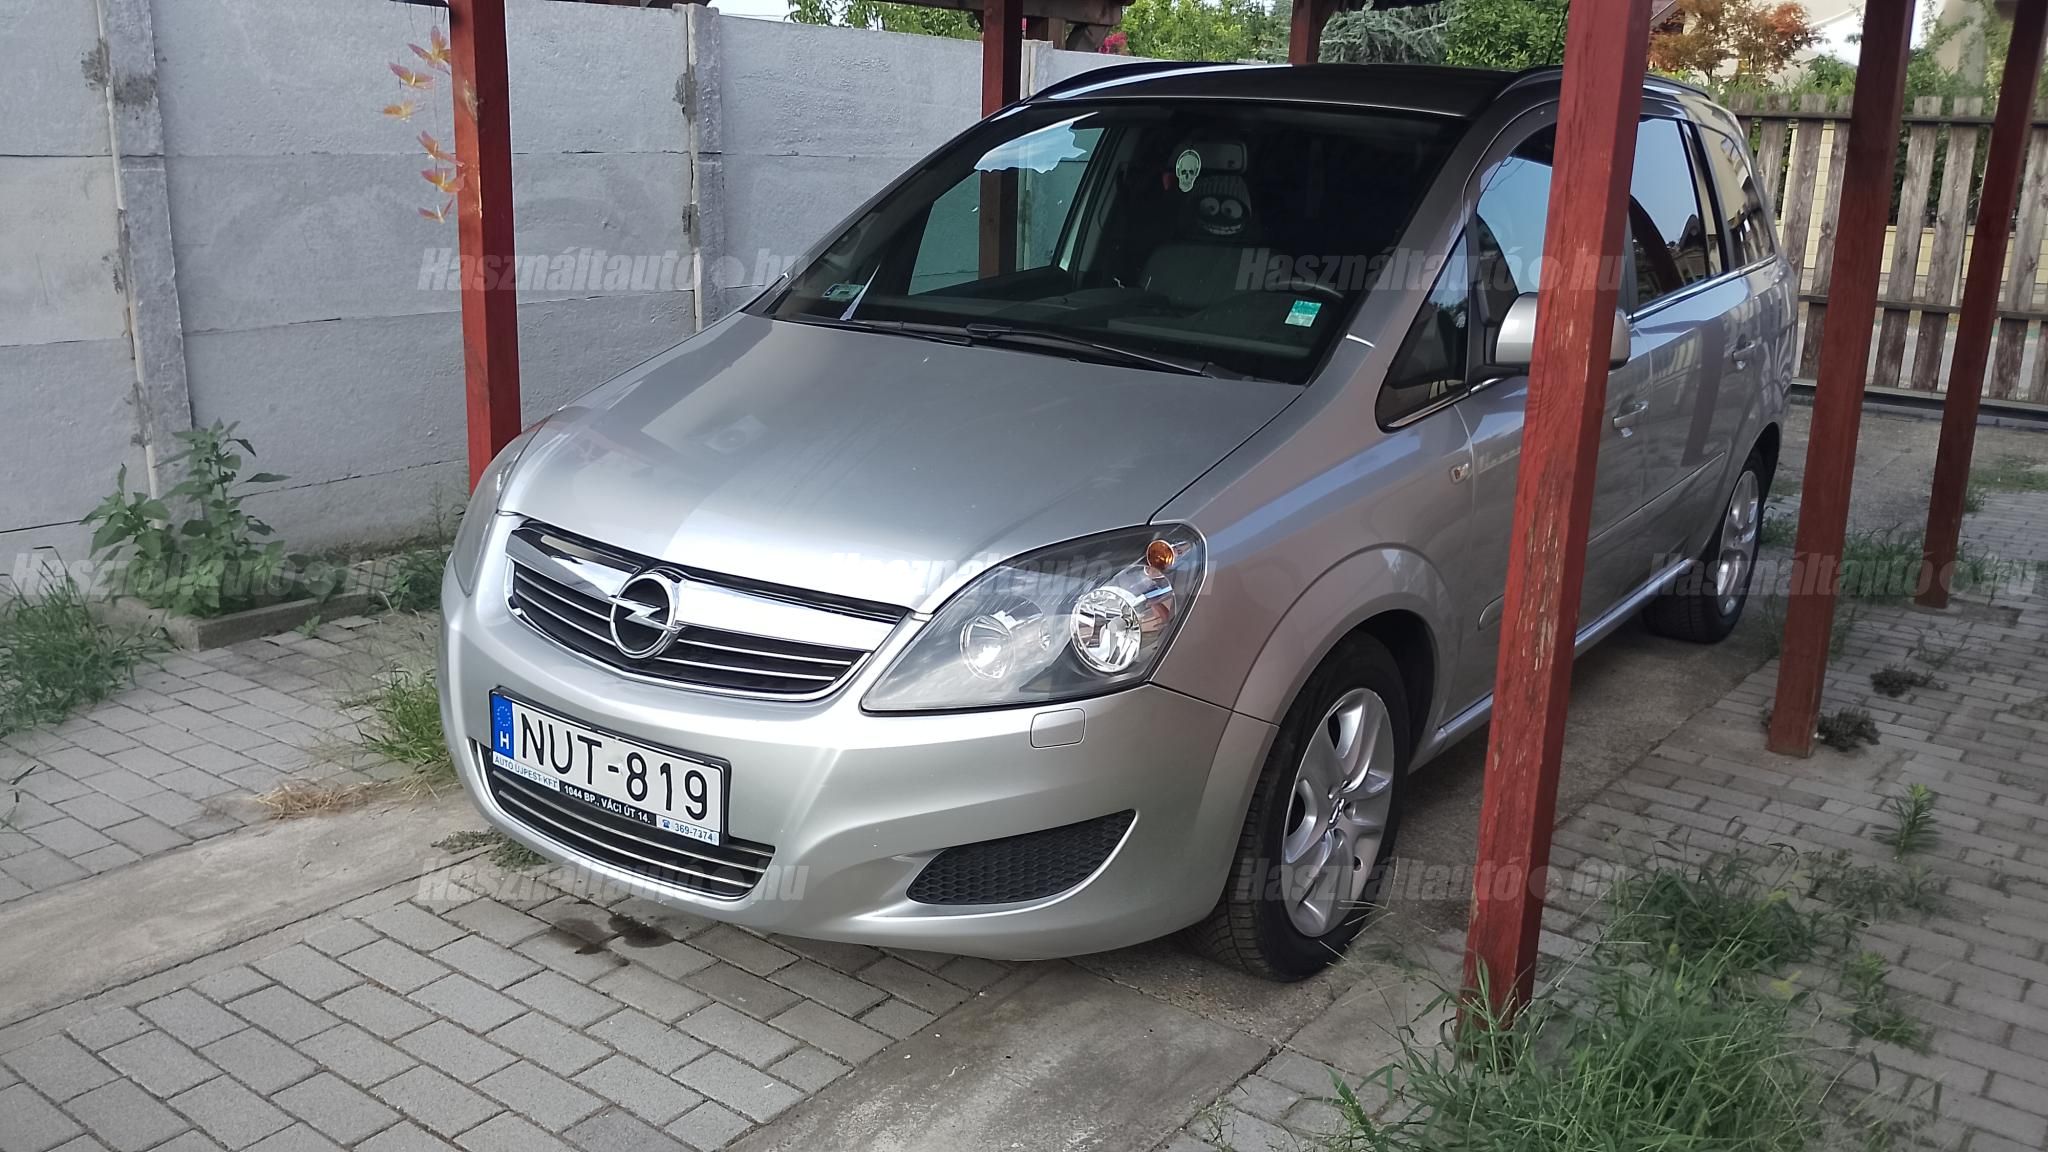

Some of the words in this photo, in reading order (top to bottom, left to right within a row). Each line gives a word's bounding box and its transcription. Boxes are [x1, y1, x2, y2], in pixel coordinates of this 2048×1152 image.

[500, 731, 510, 750] H
[521, 713, 708, 820] NUT-819
[564, 785, 582, 799] 1044
[600, 797, 622, 813] VÁCI
[623, 804, 636, 818] ÚT
[637, 811, 651, 824] 14.
[674, 822, 713, 842] 369-7374
